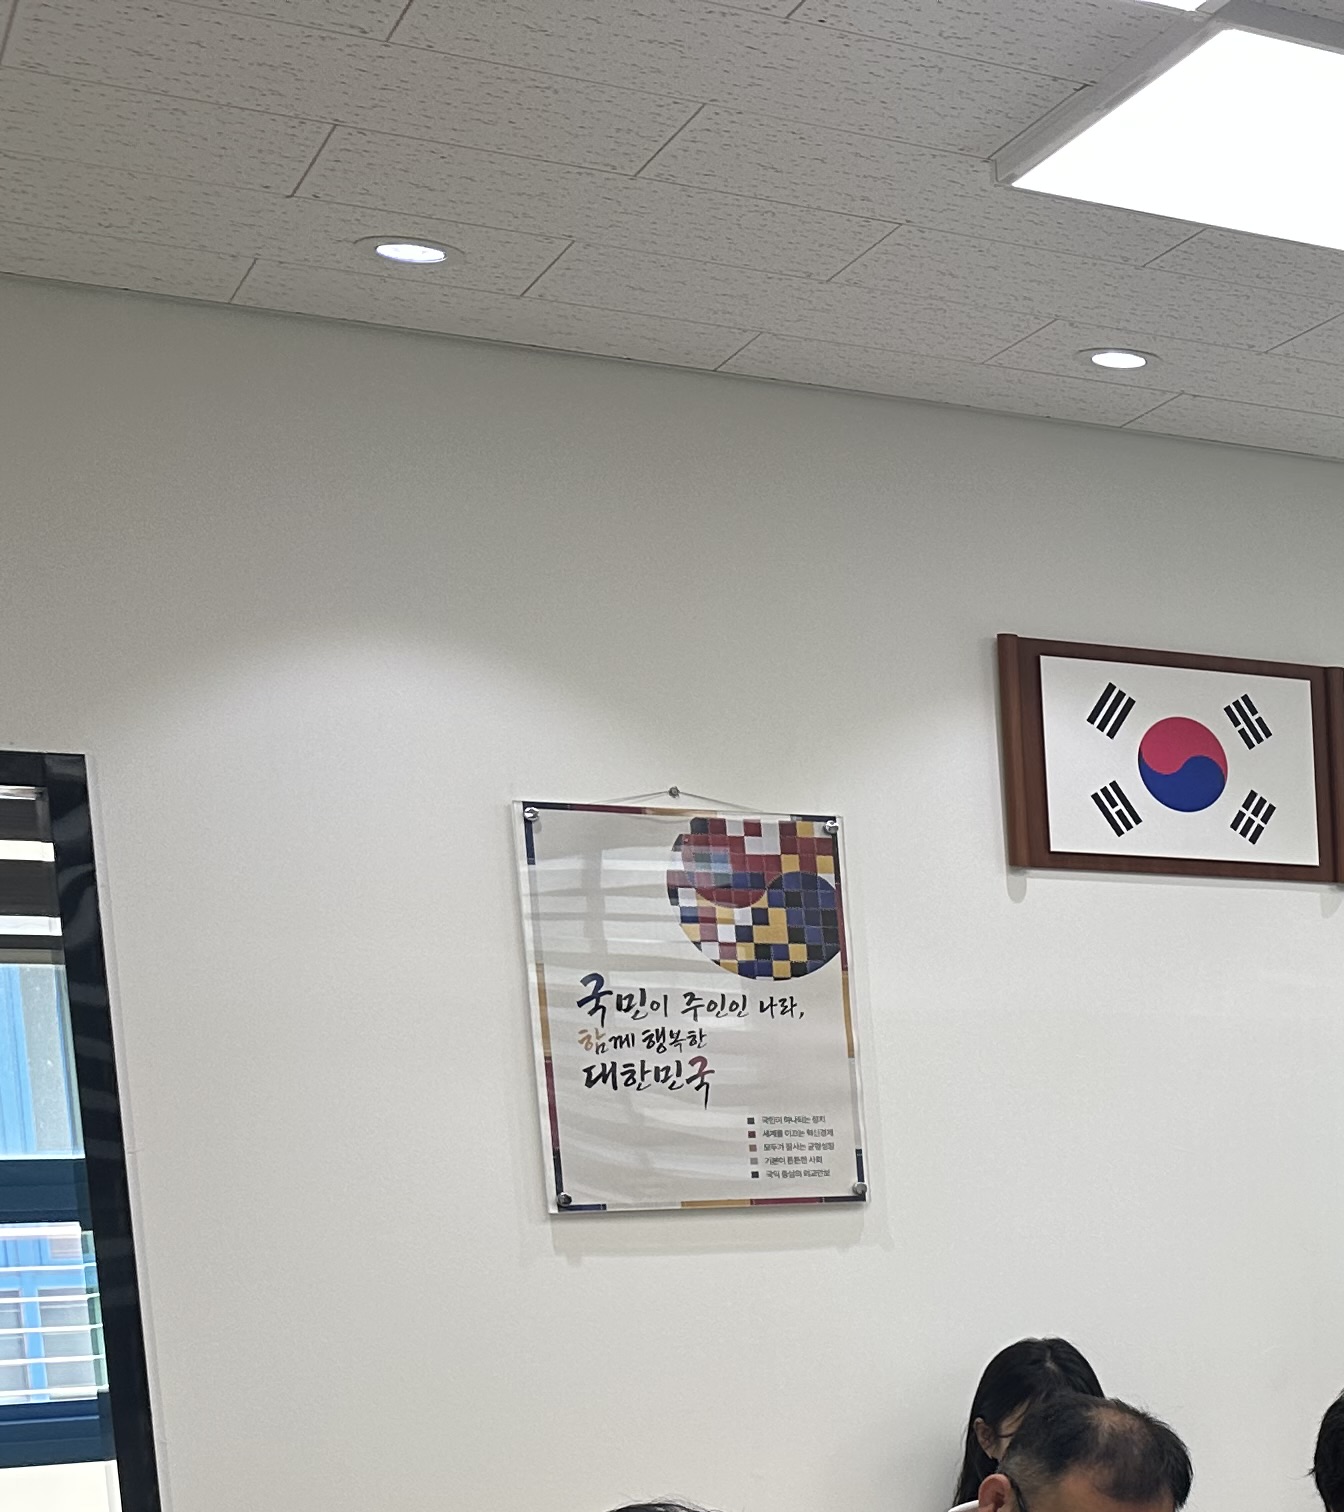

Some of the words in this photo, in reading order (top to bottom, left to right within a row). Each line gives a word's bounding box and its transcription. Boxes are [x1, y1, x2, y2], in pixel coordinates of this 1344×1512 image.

[576, 972, 668, 1029] 국민이
[680, 991, 749, 1022] 주인인
[759, 995, 805, 1020] 나라,
[577, 1026, 635, 1055] 함께
[641, 1026, 708, 1054] 행복한
[582, 1055, 716, 1111] 대한민국
